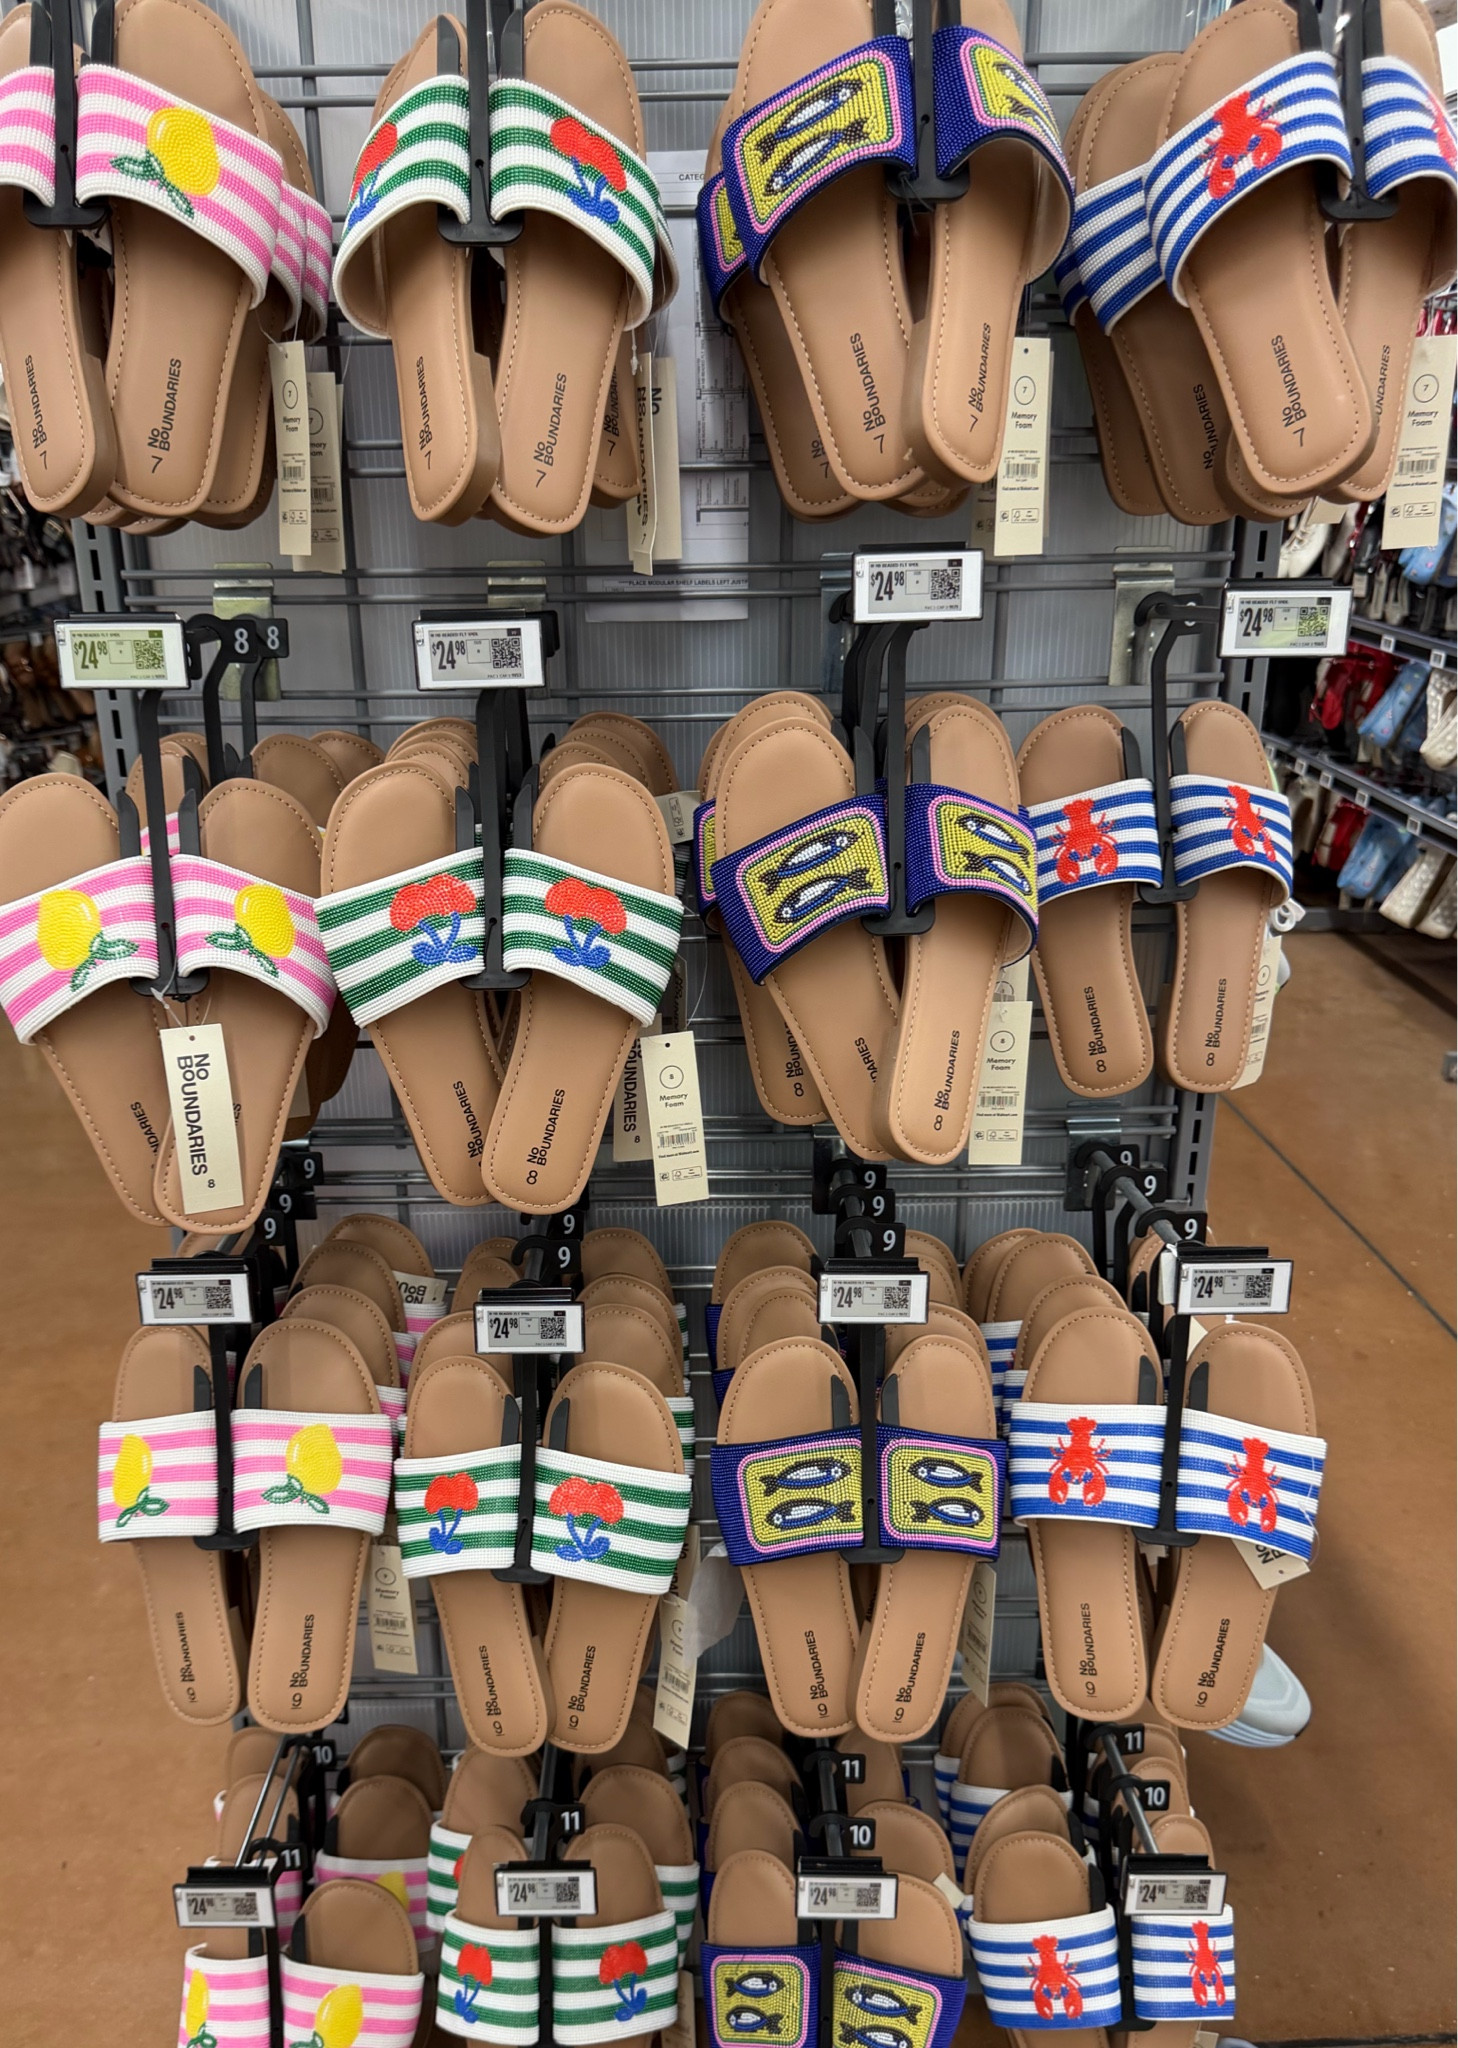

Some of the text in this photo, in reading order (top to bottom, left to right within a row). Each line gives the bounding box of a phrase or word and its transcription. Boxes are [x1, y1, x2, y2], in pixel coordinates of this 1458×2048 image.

[850, 332, 886, 427] BOUNDARIES
[974, 322, 991, 412] BOUNDARIES
[1271, 335, 1307, 422] BOUNDARIES
[1376, 345, 1390, 416] UNDARIES
[25, 355, 47, 444] BOUNDARIES
[159, 358, 182, 451] BOUNDARIES
[416, 356, 432, 444] BOUNDARIES
[544, 373, 567, 467] BOUNDARIES
[1011, 411, 1037, 421] Memory
[1015, 421, 1032, 429] Foam
[1193, 384, 1219, 453] UNDARIES
[1407, 410, 1438, 418] Memory
[310, 442, 326, 450] mory
[235, 628, 249, 654] 8
[267, 626, 279, 650] 8
[1084, 986, 1107, 1054] BOUNDARIES
[1212, 978, 1227, 1048] BOUNDARIES
[784, 1022, 804, 1077] BOUNDA
[854, 1037, 878, 1079] DARIES
[986, 1057, 1016, 1065] Memory
[194, 1053, 210, 1081] NO
[941, 1030, 960, 1110] BOUNDARIES
[623, 1042, 638, 1132] OUNDARIES
[660, 1093, 688, 1101] Memory
[130, 1101, 160, 1153] NDARIES
[177, 1055, 208, 1176] BOUNDARIES
[537, 1089, 565, 1166] BOUNDARIES
[634, 1135, 640, 1144] 8
[304, 1159, 315, 1179] 9
[1120, 1151, 1132, 1165] 9
[208, 1179, 215, 1188] 8
[864, 1171, 876, 1189] 9
[1144, 1175, 1156, 1196] 9
[279, 1194, 292, 1213] 9
[872, 1196, 885, 1217] 9
[264, 1218, 276, 1239] 9
[563, 1214, 575, 1234] 9
[1184, 1219, 1198, 1240] 9
[883, 1230, 896, 1251] 9
[558, 1246, 571, 1268] 9
[300, 1614, 315, 1687] BOUNDARIES
[1081, 1603, 1097, 1676] BOUNDARIES
[805, 1630, 828, 1698] BOUNDARIES
[1206, 1618, 1231, 1688] BOUNDARIES
[479, 1645, 502, 1715] BOUNDARIES
[576, 1645, 596, 1712] BOUNDARIES
[904, 1632, 926, 1703] BOUNDARIES
[1125, 1730, 1142, 1751] 11
[313, 1746, 333, 1764] 10
[842, 1759, 860, 1778] 11
[1145, 1786, 1165, 1806] 10
[561, 1811, 580, 1831] 11
[850, 1825, 871, 1845] 10
[281, 1849, 300, 1867] 11
